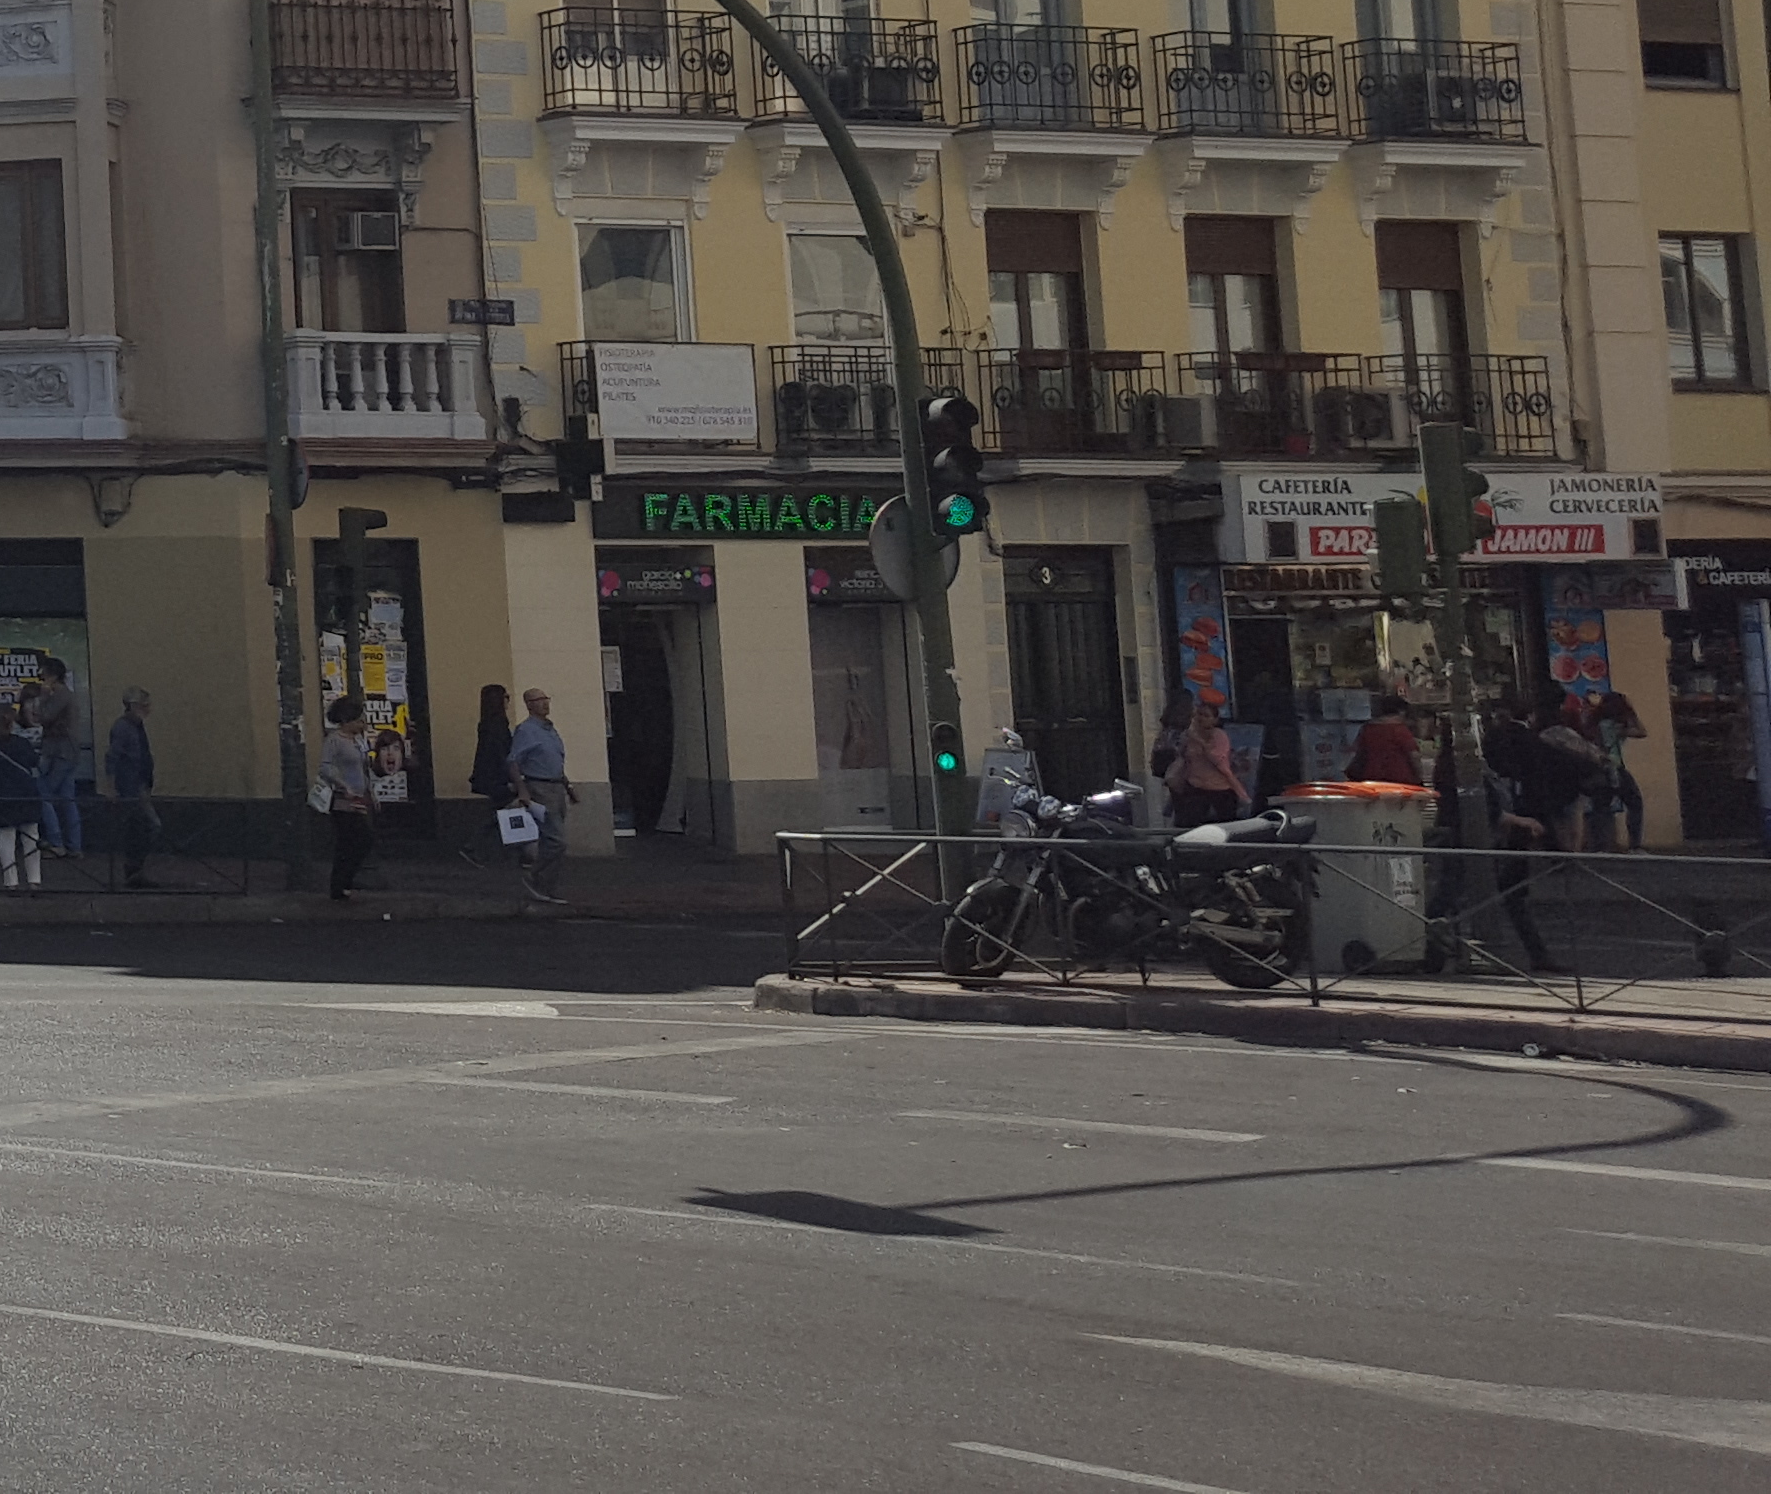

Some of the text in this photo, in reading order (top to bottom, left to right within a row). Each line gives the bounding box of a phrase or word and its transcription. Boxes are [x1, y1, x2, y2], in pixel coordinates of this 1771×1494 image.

[602, 392, 636, 401] PILATES
[1258, 477, 1352, 494] CAFETERÍA
[1549, 477, 1658, 495] JAMONERÍA
[643, 492, 878, 532] FARMACIA
[1247, 500, 1368, 516] RESTAURANTE
[1549, 498, 1659, 514] CERVECERÍA
[1487, 527, 1569, 553] JAMON
[1574, 527, 1595, 551] III
[1683, 554, 1723, 570] DERÍA
[1041, 566, 1051, 584] 3
[1709, 568, 1771, 585] CAFETERÍ
[4, 654, 38, 665] FERIA
[366, 712, 394, 724] TLET
